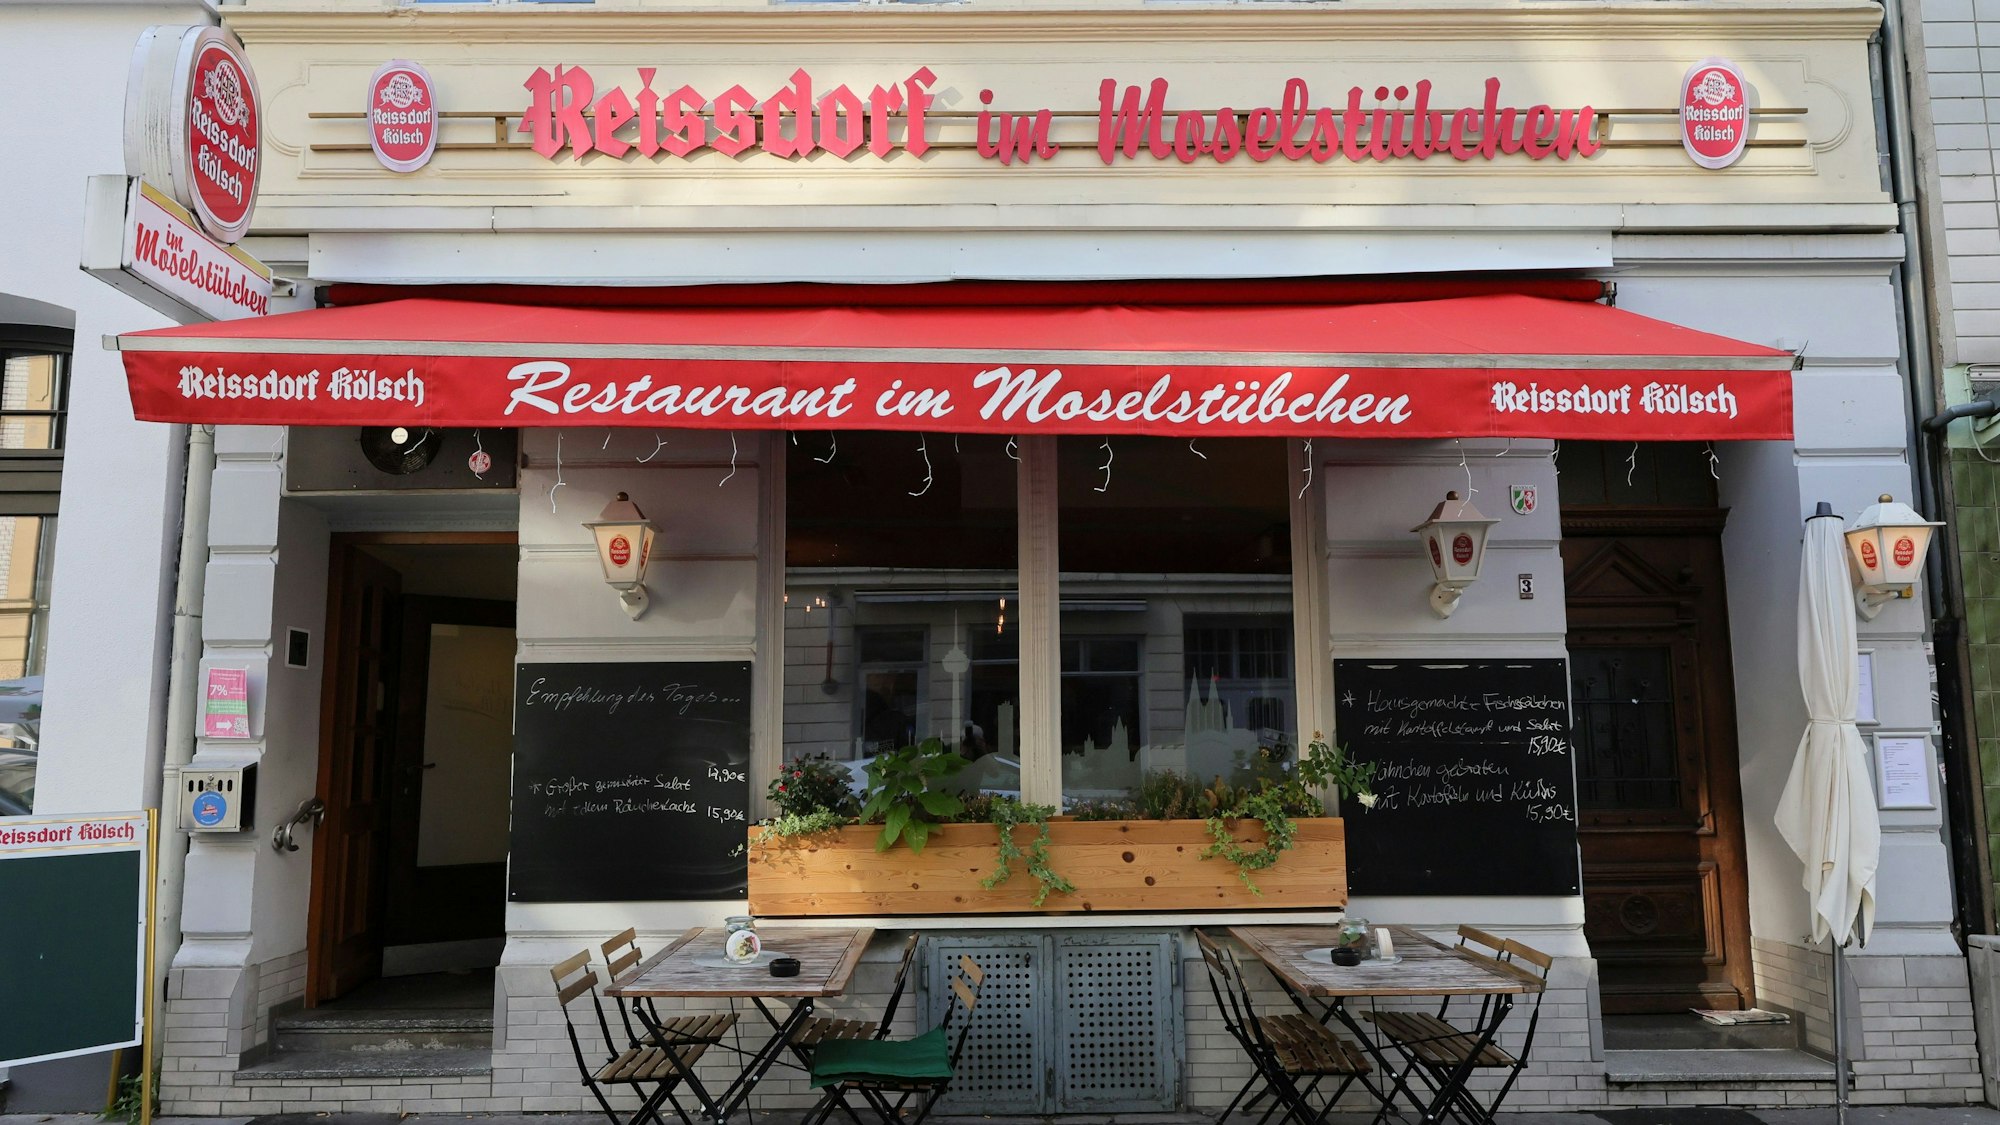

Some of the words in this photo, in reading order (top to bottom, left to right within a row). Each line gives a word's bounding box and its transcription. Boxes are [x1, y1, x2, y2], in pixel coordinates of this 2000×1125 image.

[373, 107, 431, 125] Reissdorf
[517, 63, 937, 162] Reissdorf
[976, 88, 1059, 165] im
[1099, 76, 1601, 165] Moselstübchen
[1685, 104, 1744, 121] Reissdorf
[192, 96, 256, 173] Reissdorf
[382, 127, 424, 146] Kölsch
[1694, 124, 1735, 143] Kölsch
[198, 143, 243, 205] Kölsch
[166, 223, 183, 253] im
[135, 222, 268, 316] Moselstübchen
[177, 365, 320, 401] Reissdorf
[326, 366, 425, 407] Kölsch
[503, 360, 857, 418] Restaurant
[874, 379, 955, 418] im
[972, 366, 1413, 425] Moselstübchen
[1490, 380, 1632, 415] Reissdorf
[1639, 381, 1738, 420] Kölsch
[1522, 579, 1532, 593] 3
[209, 684, 228, 696] 7%
[526, 677, 624, 714] Empfehlung
[1363, 717, 1393, 736] mit
[1498, 721, 1522, 733] und
[1526, 717, 1563, 732] Salat
[1527, 735, 1567, 757] 15,90€
[545, 775, 590, 796] Großer
[653, 773, 691, 791] Salat
[1476, 783, 1503, 803] und
[707, 805, 745, 824] 15,90€
[1526, 803, 1574, 824] 15,90€
[0, 826, 74, 845] eissdorf
[78, 822, 135, 841] Kölsch
